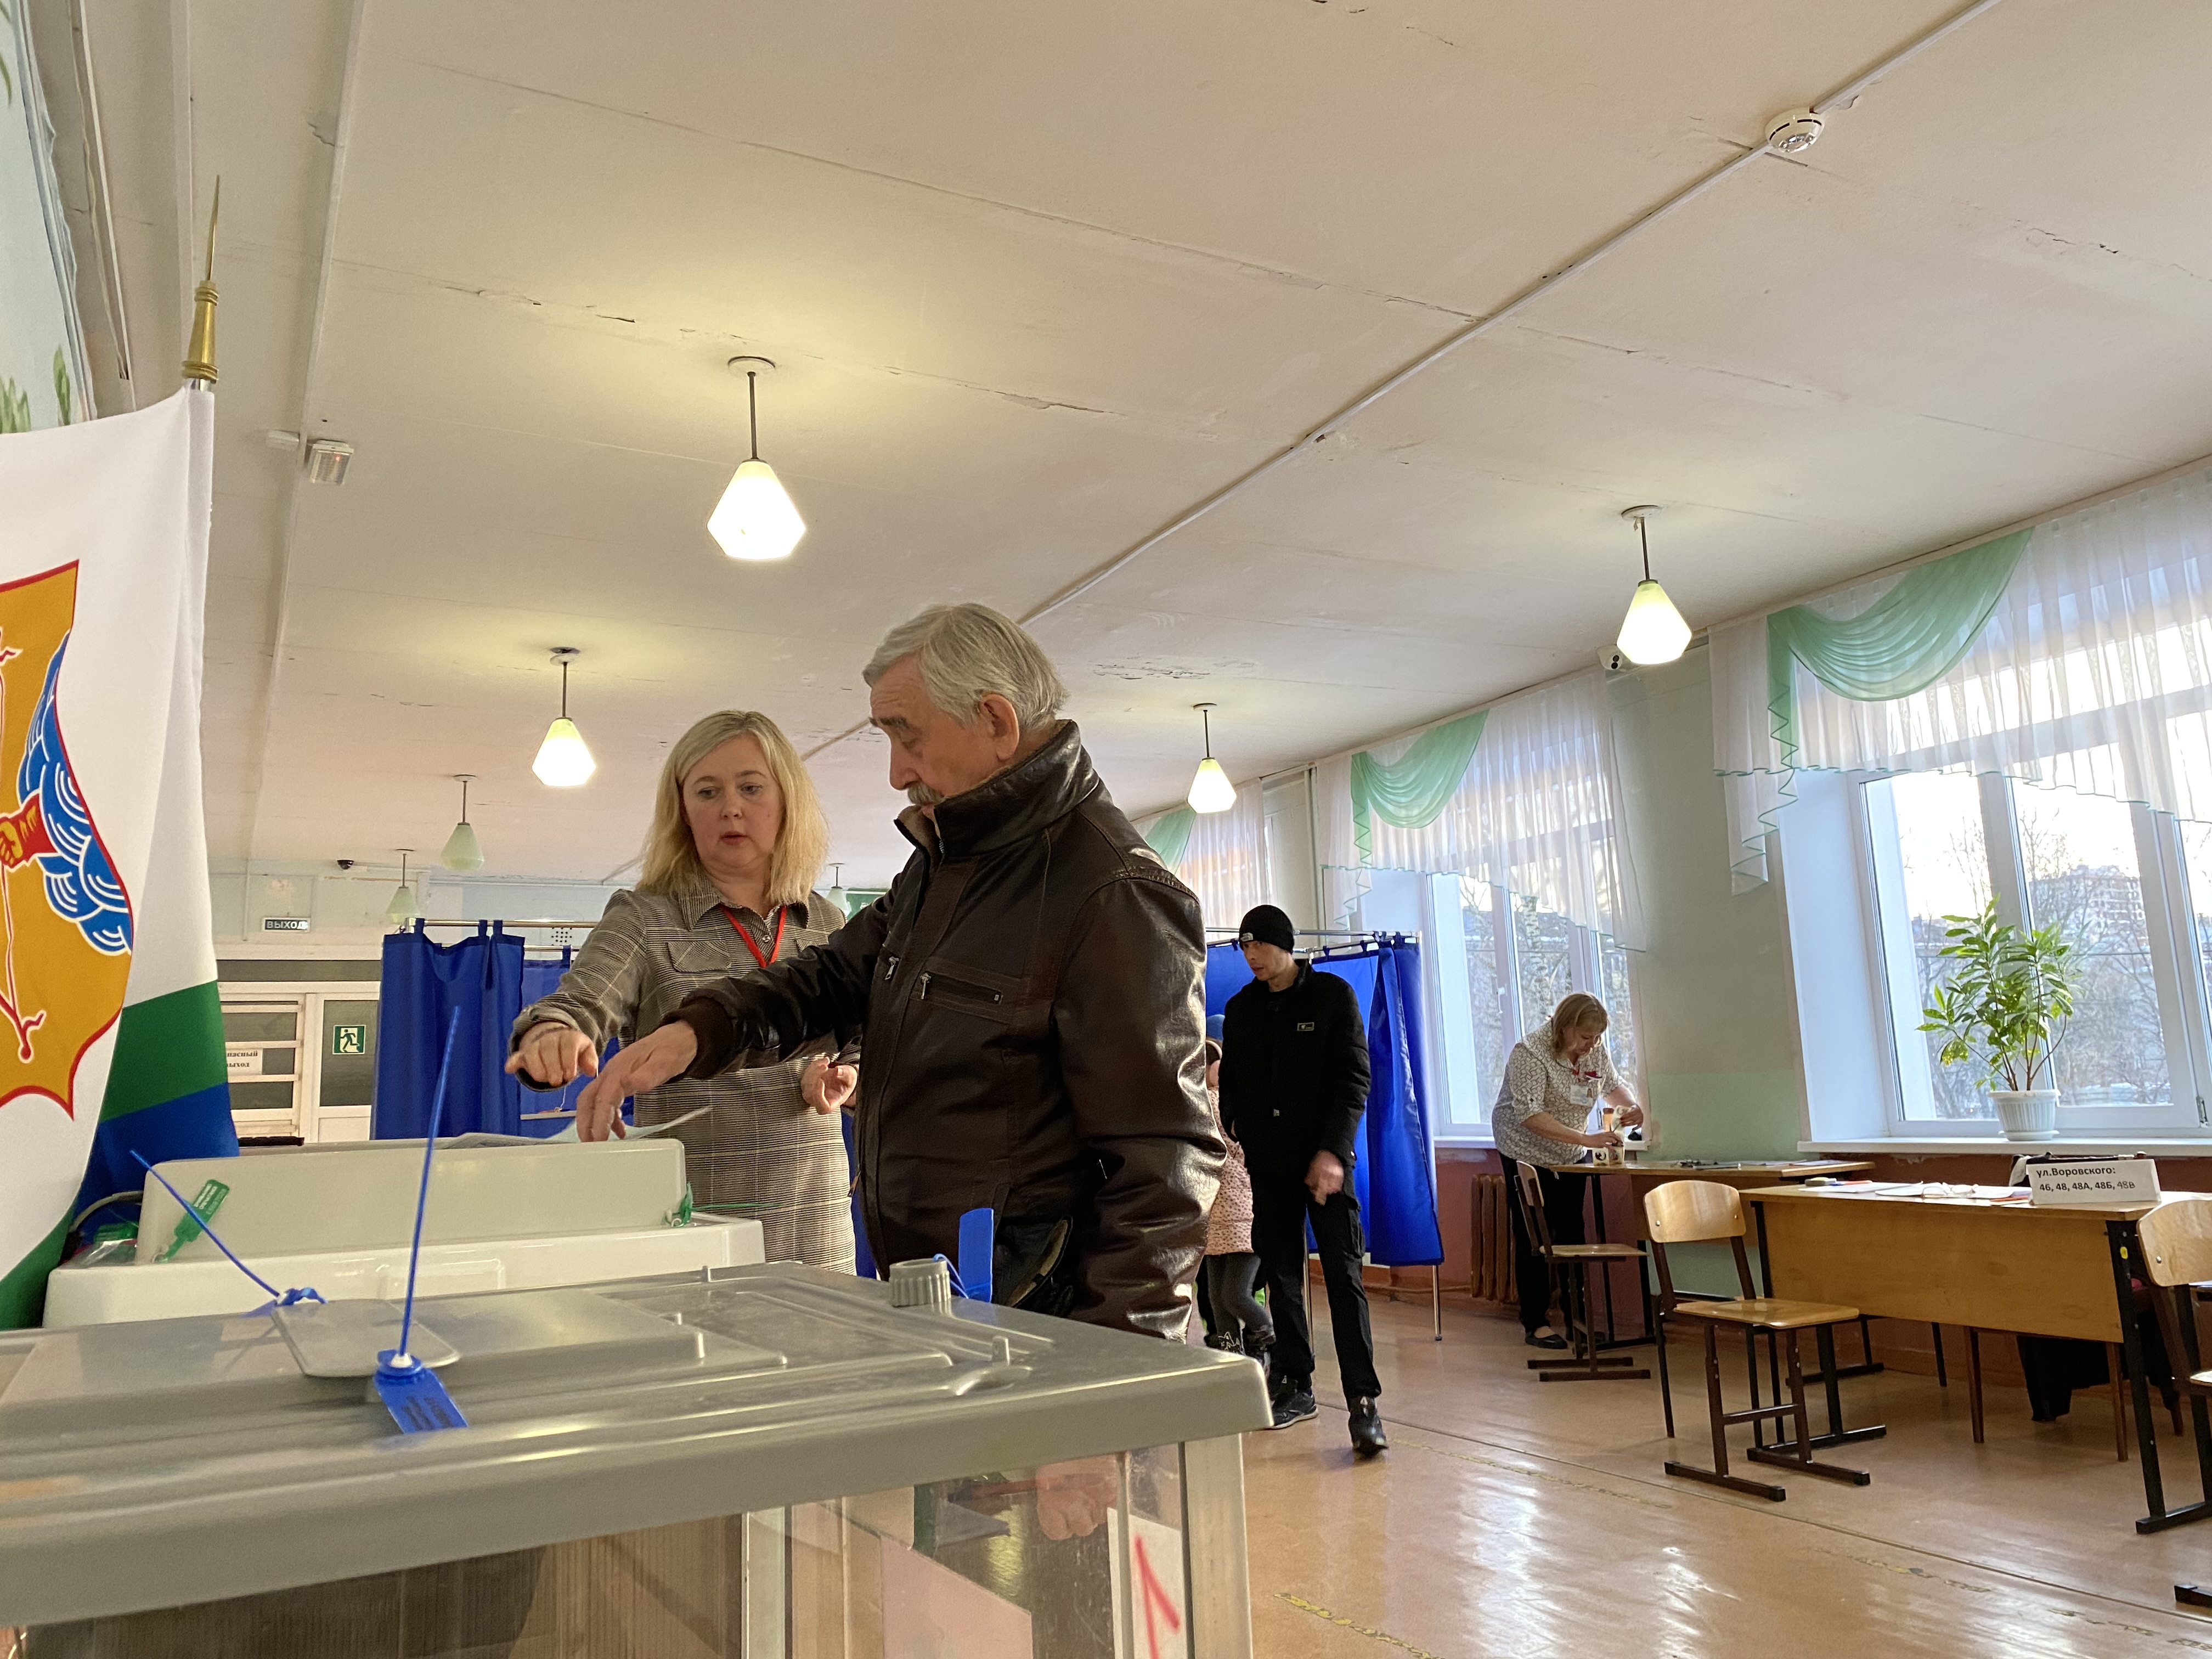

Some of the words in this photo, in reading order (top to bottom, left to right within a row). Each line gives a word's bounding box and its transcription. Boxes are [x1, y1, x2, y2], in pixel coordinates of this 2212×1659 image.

[267, 921, 307, 929] ВЫХОД
[2036, 1167, 2116, 1178] ул.Воровского:
[2040, 1183, 2054, 1192] 46,
[2056, 1183, 2070, 1192] 48,
[2072, 1182, 2092, 1190] 48А,
[2095, 1182, 2115, 1190] 48Б,
[2117, 1181, 2135, 1189] 48В
